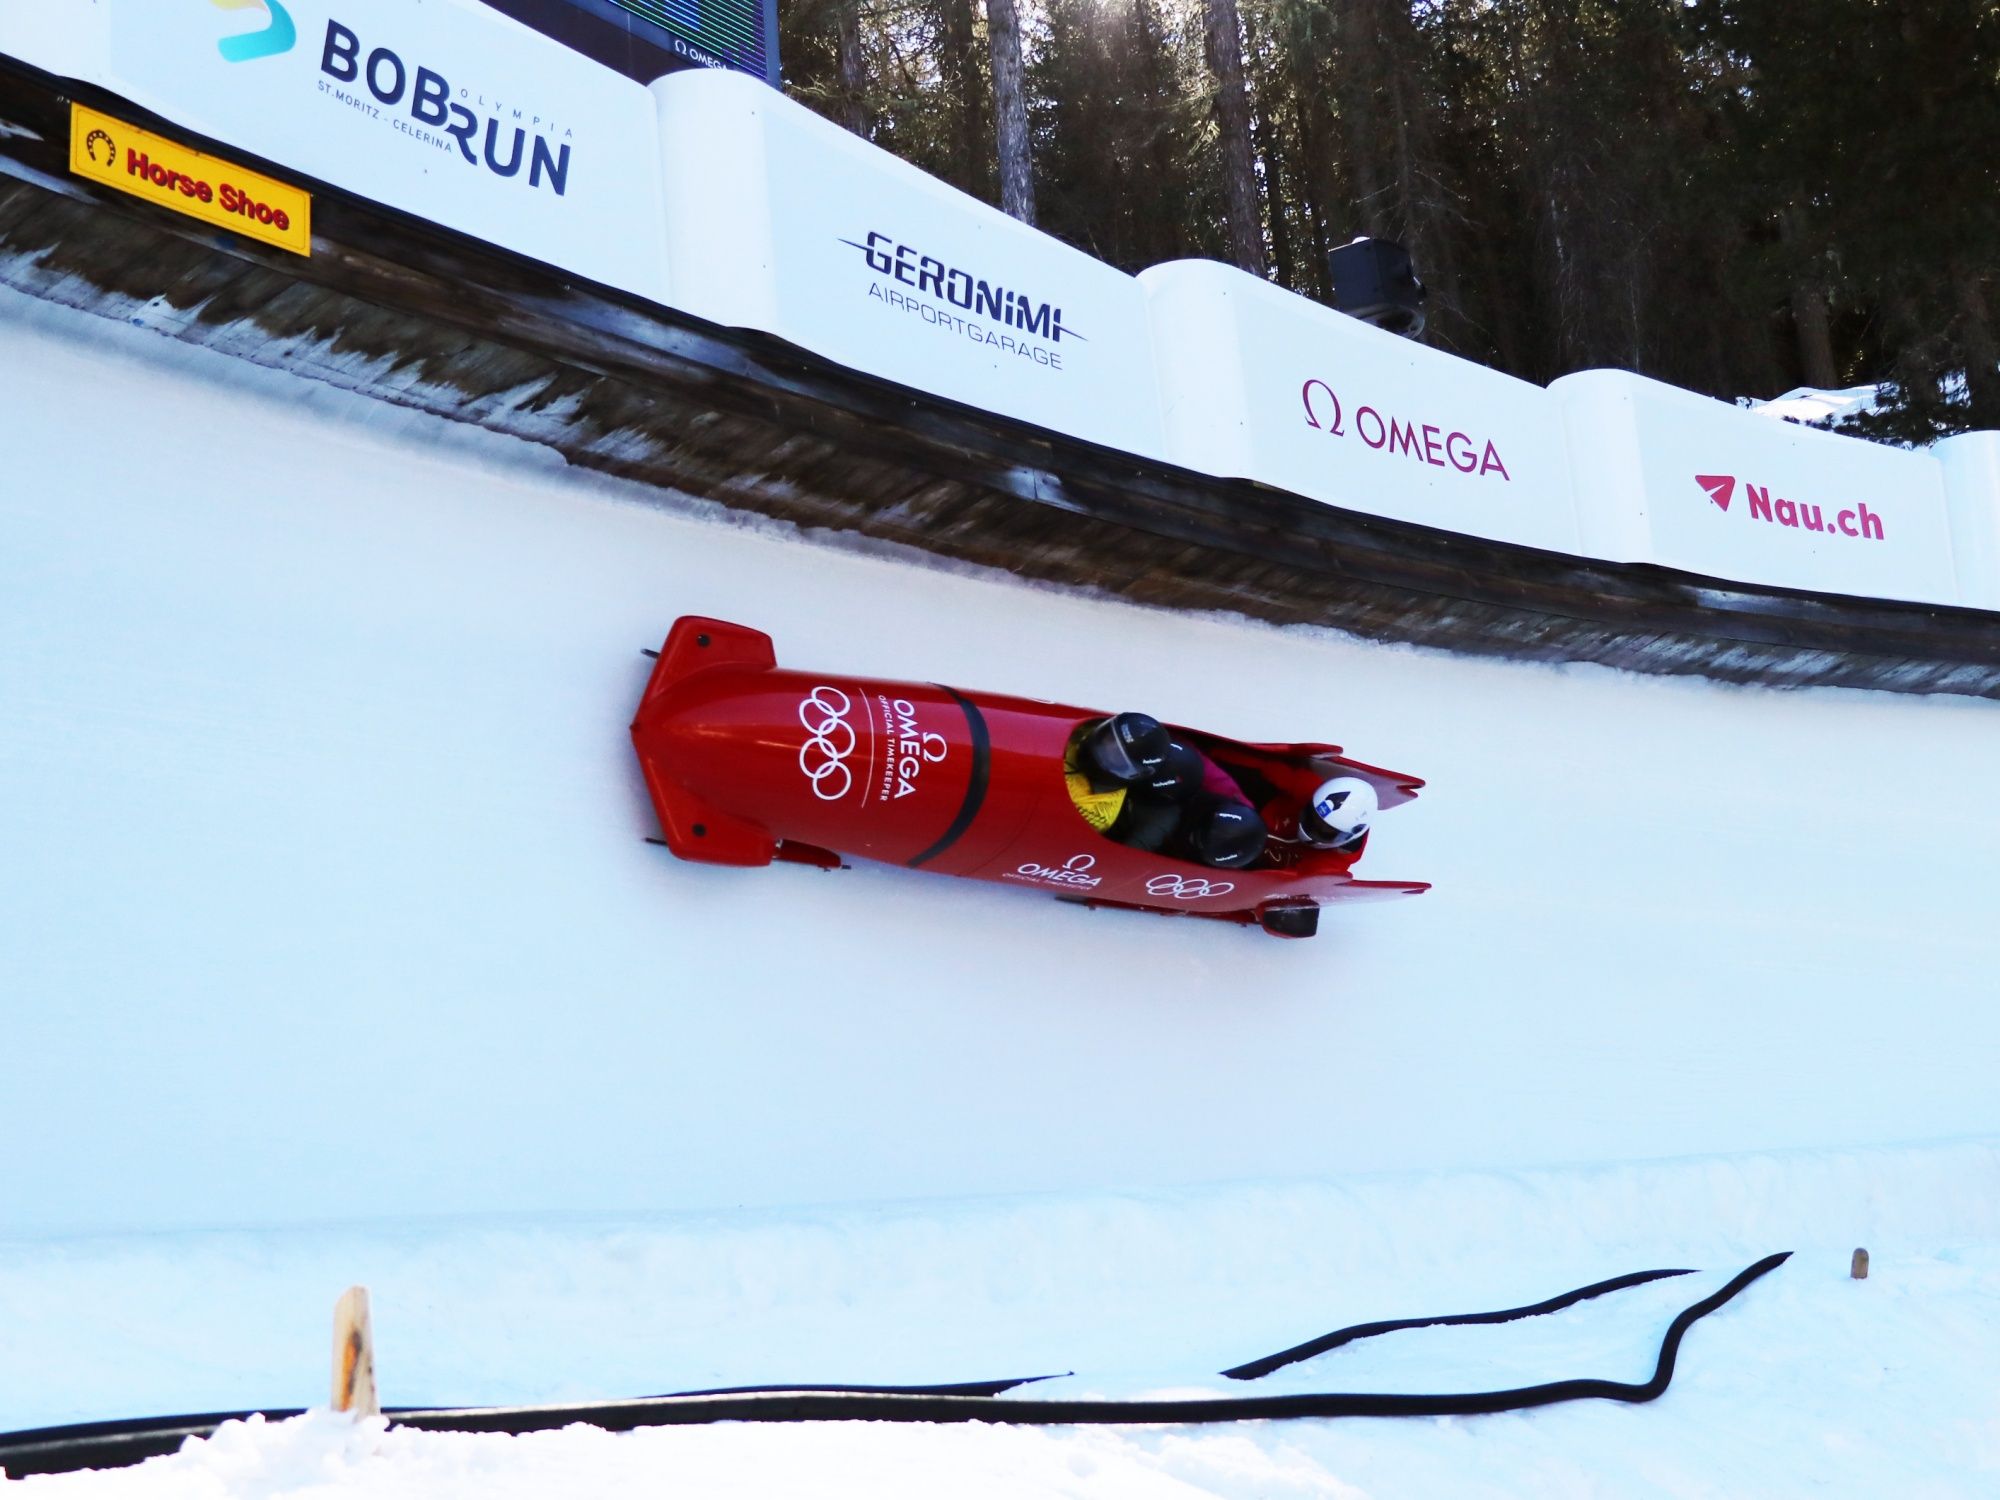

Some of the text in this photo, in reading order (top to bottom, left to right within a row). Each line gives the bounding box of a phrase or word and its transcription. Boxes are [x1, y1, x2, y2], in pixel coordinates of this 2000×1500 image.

[392, 118, 452, 153] CELERINA
[460, 88, 573, 138] OLYMPIA
[127, 148, 290, 231] Horse Shoe
[868, 282, 1063, 370] AIRPORTGARAGE
[1356, 406, 1511, 481] OMEGA
[1745, 483, 1885, 540] Nau.ch
[877, 694, 896, 801] OFFICIAL TIMEKEEPER
[893, 699, 921, 799] OMEGA
[1017, 863, 1102, 886] OMEGA
